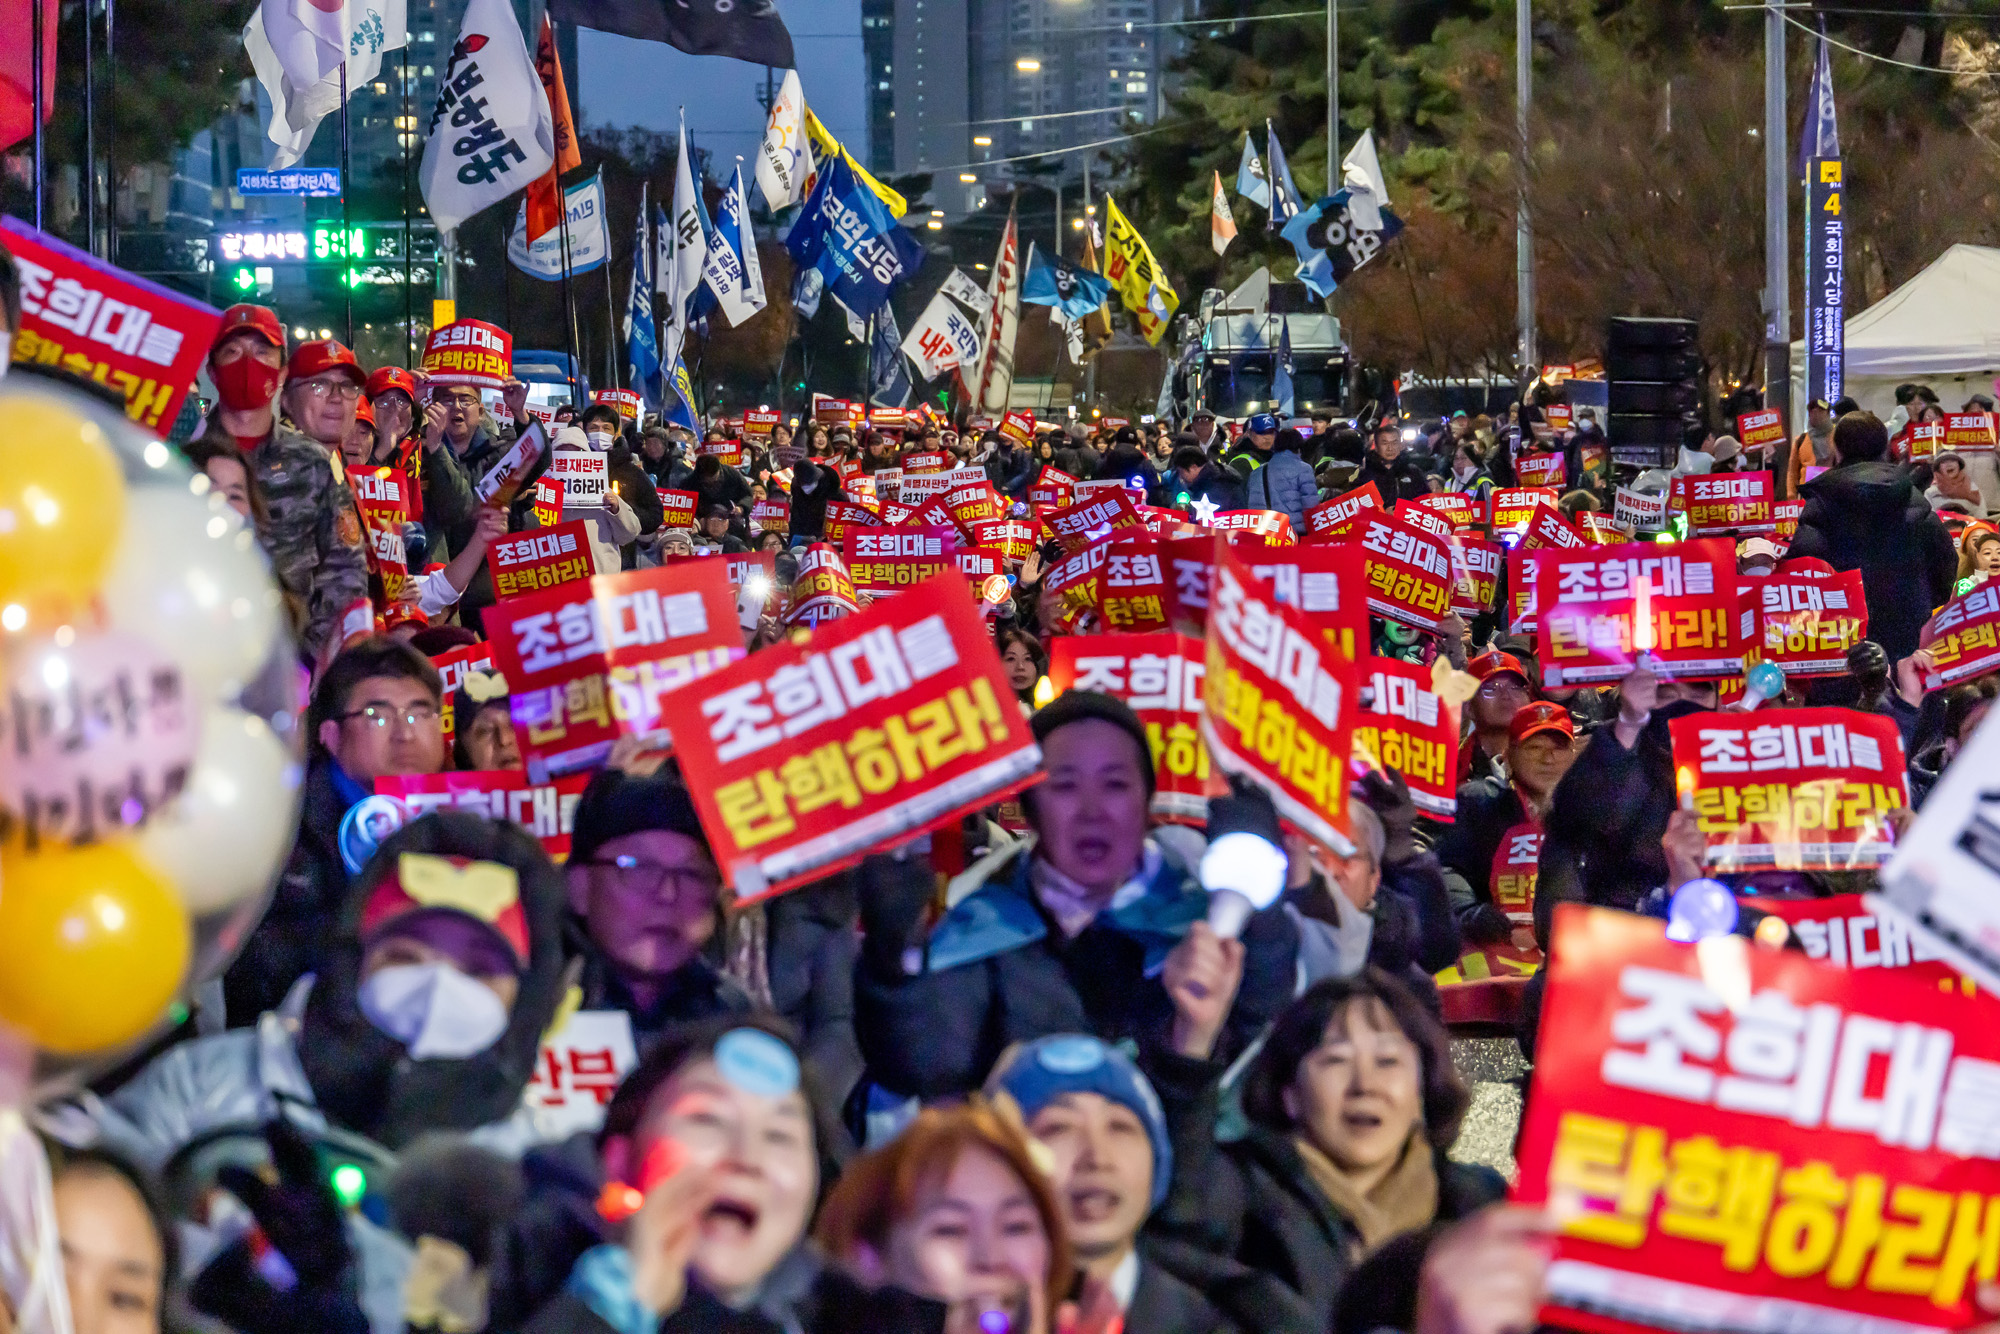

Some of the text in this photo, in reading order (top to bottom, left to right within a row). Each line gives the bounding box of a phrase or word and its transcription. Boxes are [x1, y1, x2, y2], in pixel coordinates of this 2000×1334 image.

[240, 174, 280, 190] 지하차도
[1823, 193, 1842, 216] 4
[1824, 220, 1843, 308] 국회의사당
[15, 255, 184, 367] 조희대를
[432, 325, 505, 354] 조희대를
[423, 351, 510, 379] 탄핵하라!
[906, 455, 944, 469] 조희대를
[1519, 458, 1558, 474] 조희대를
[944, 488, 988, 509] 조희대를
[1693, 479, 1764, 500] 조희대를
[1053, 498, 1123, 536] 조희대를
[1311, 493, 1374, 532] 조희대를
[1690, 503, 1770, 525] 탄핵하라!
[496, 533, 577, 566] 조희대를
[855, 534, 943, 557] 조희대를
[983, 524, 1032, 541] 조희대를
[1362, 520, 1449, 580] 조희대를
[496, 556, 589, 596] 탄핵하라!
[954, 554, 995, 575] 대를
[1558, 555, 1714, 603] 조희대를
[1762, 583, 1850, 613] 희대를
[511, 587, 709, 674] 조희대를
[1215, 563, 1343, 732] 조희대를
[1763, 616, 1861, 655] 핵하라!
[701, 613, 960, 764] 조희대를
[714, 676, 1010, 852] 탄핵하라!
[1699, 724, 1884, 774] 조희대를
[1693, 779, 1902, 834] 탄핵하라!
[1601, 964, 2000, 1162] 조희대를
